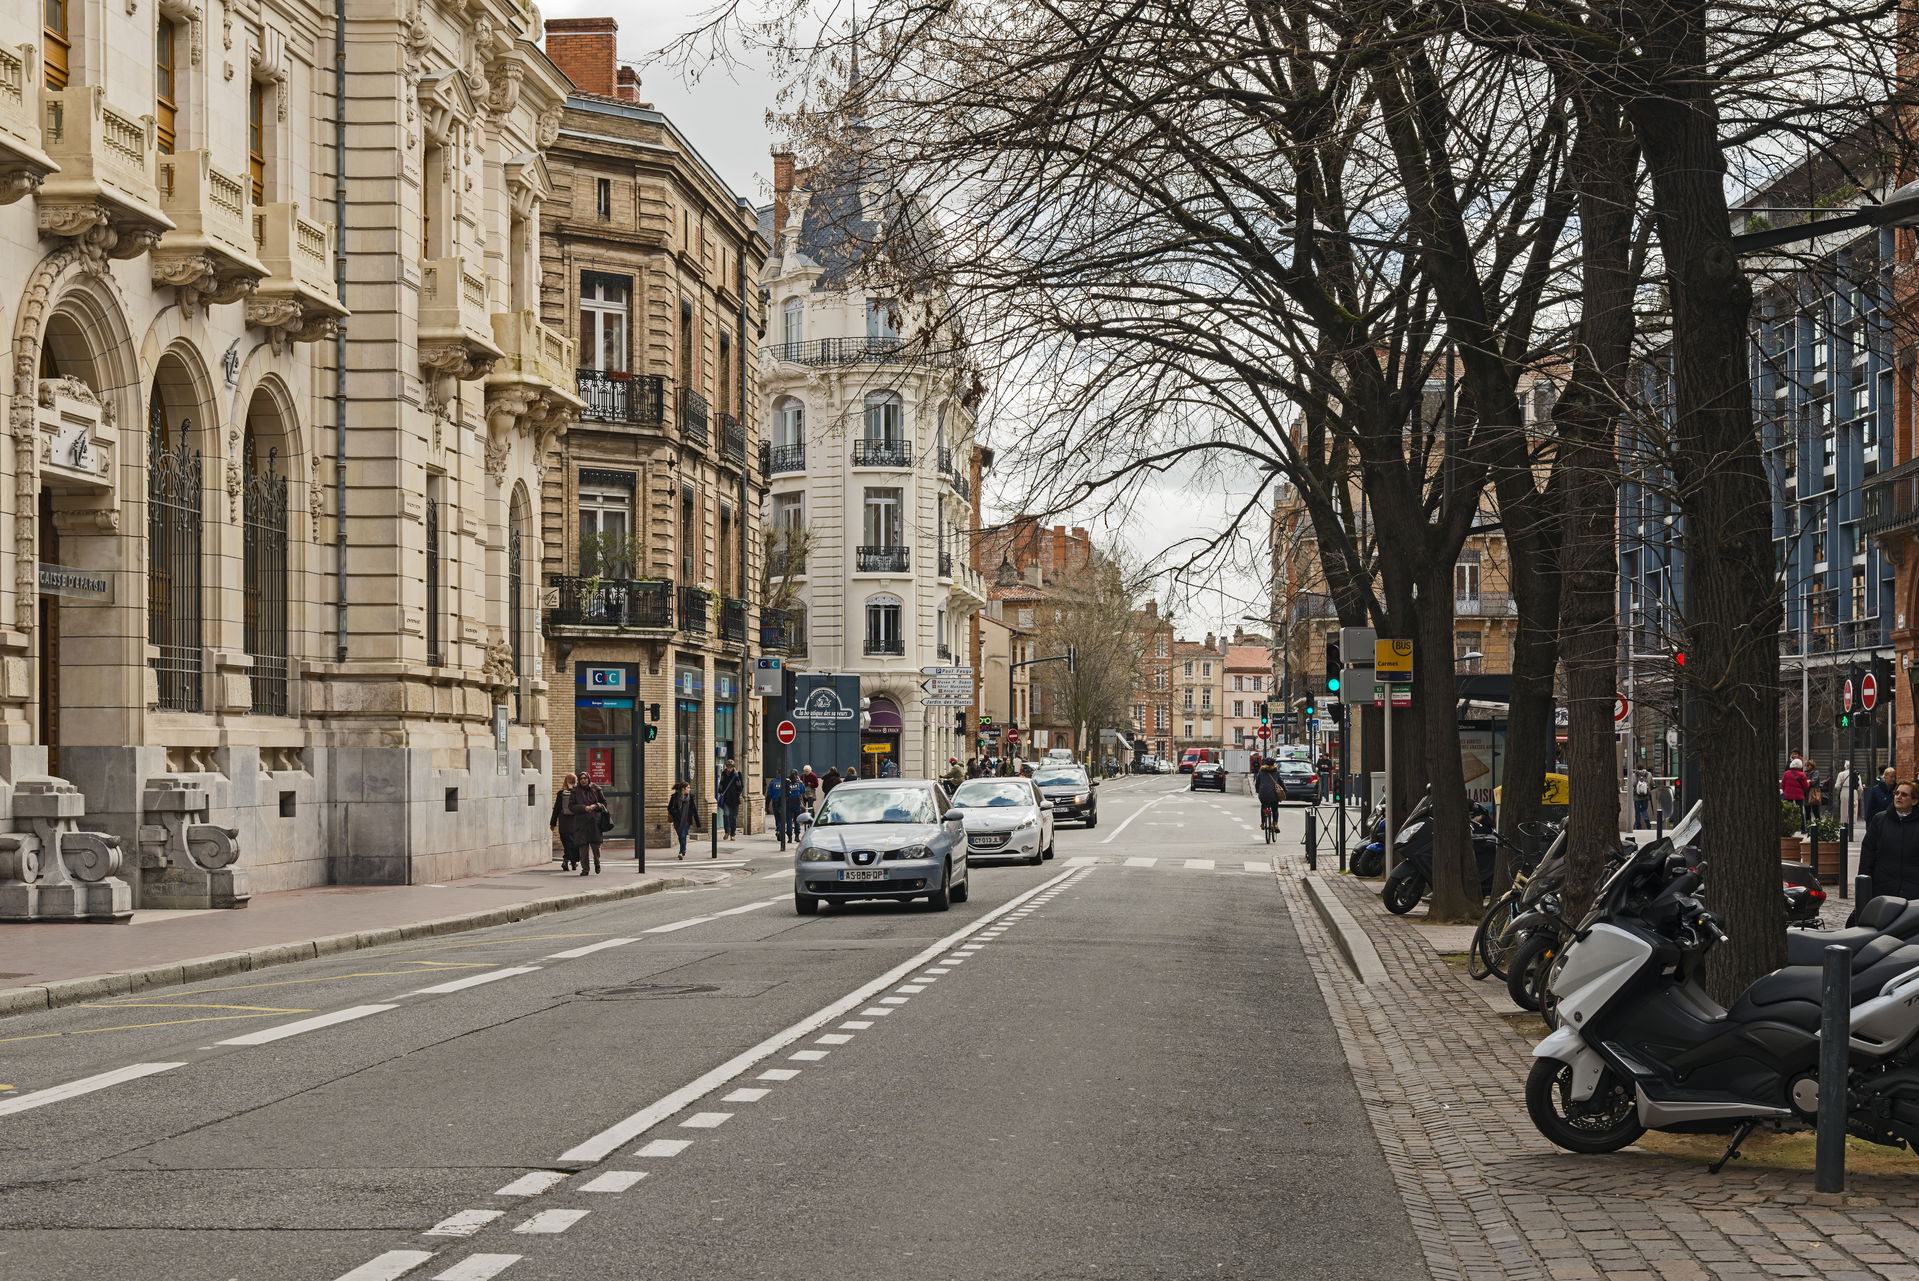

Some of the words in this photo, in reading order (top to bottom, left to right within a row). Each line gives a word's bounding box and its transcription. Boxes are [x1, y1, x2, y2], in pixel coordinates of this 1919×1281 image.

[40, 571, 67, 587] CAISSE
[1395, 640, 1411, 650] BUS
[760, 660, 779, 668] CIC
[595, 672, 617, 683] CIC
[1466, 788, 1492, 803] LAISI
